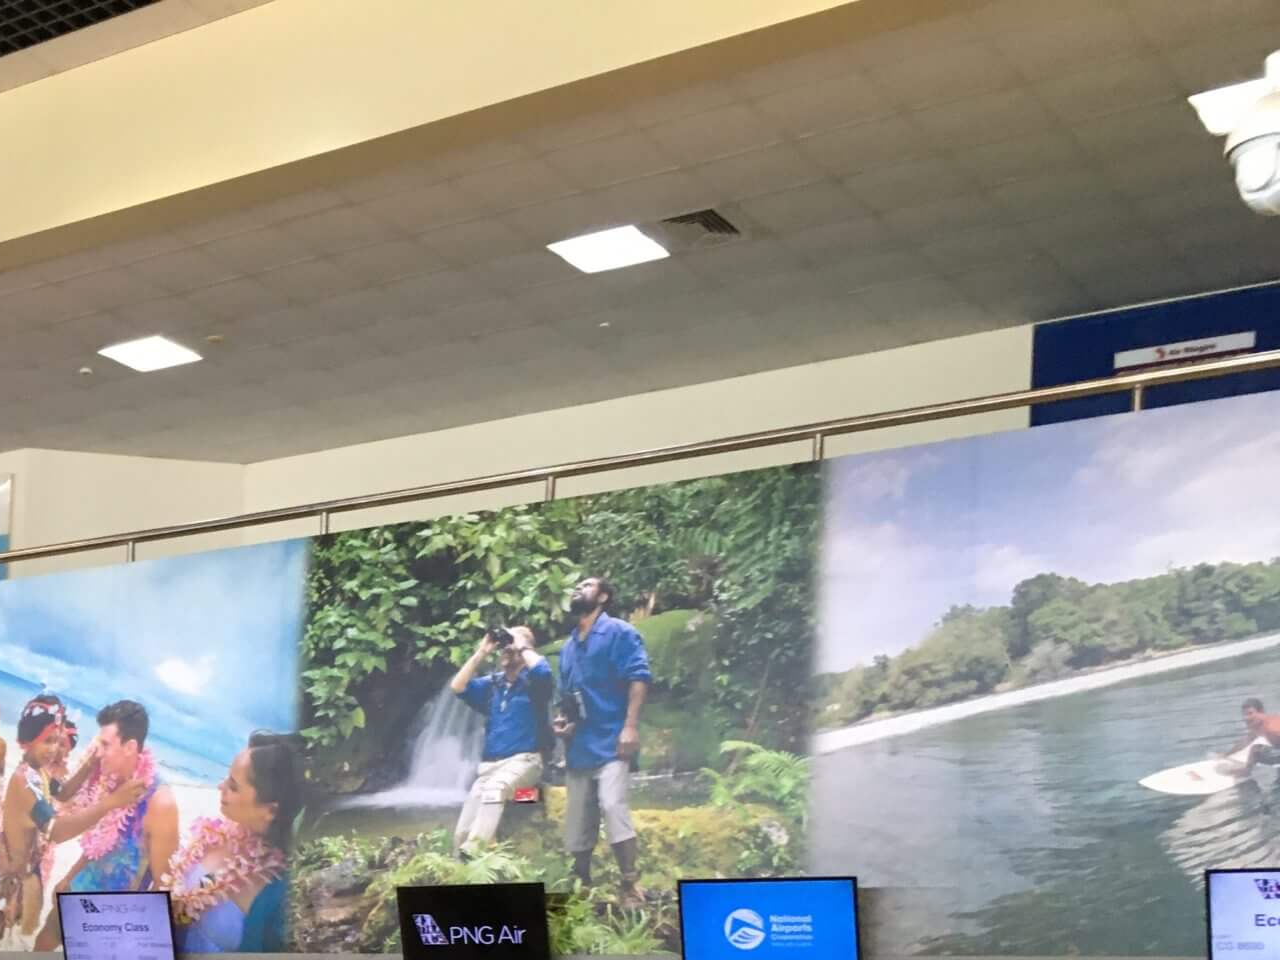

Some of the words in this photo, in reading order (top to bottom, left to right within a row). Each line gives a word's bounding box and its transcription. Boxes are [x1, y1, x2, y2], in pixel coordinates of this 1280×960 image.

[82, 923, 123, 934] Economy
[124, 922, 150, 932] Class
[1254, 913, 1280, 928] Ec
[449, 925, 495, 945] PNG
[498, 924, 527, 944] Air
